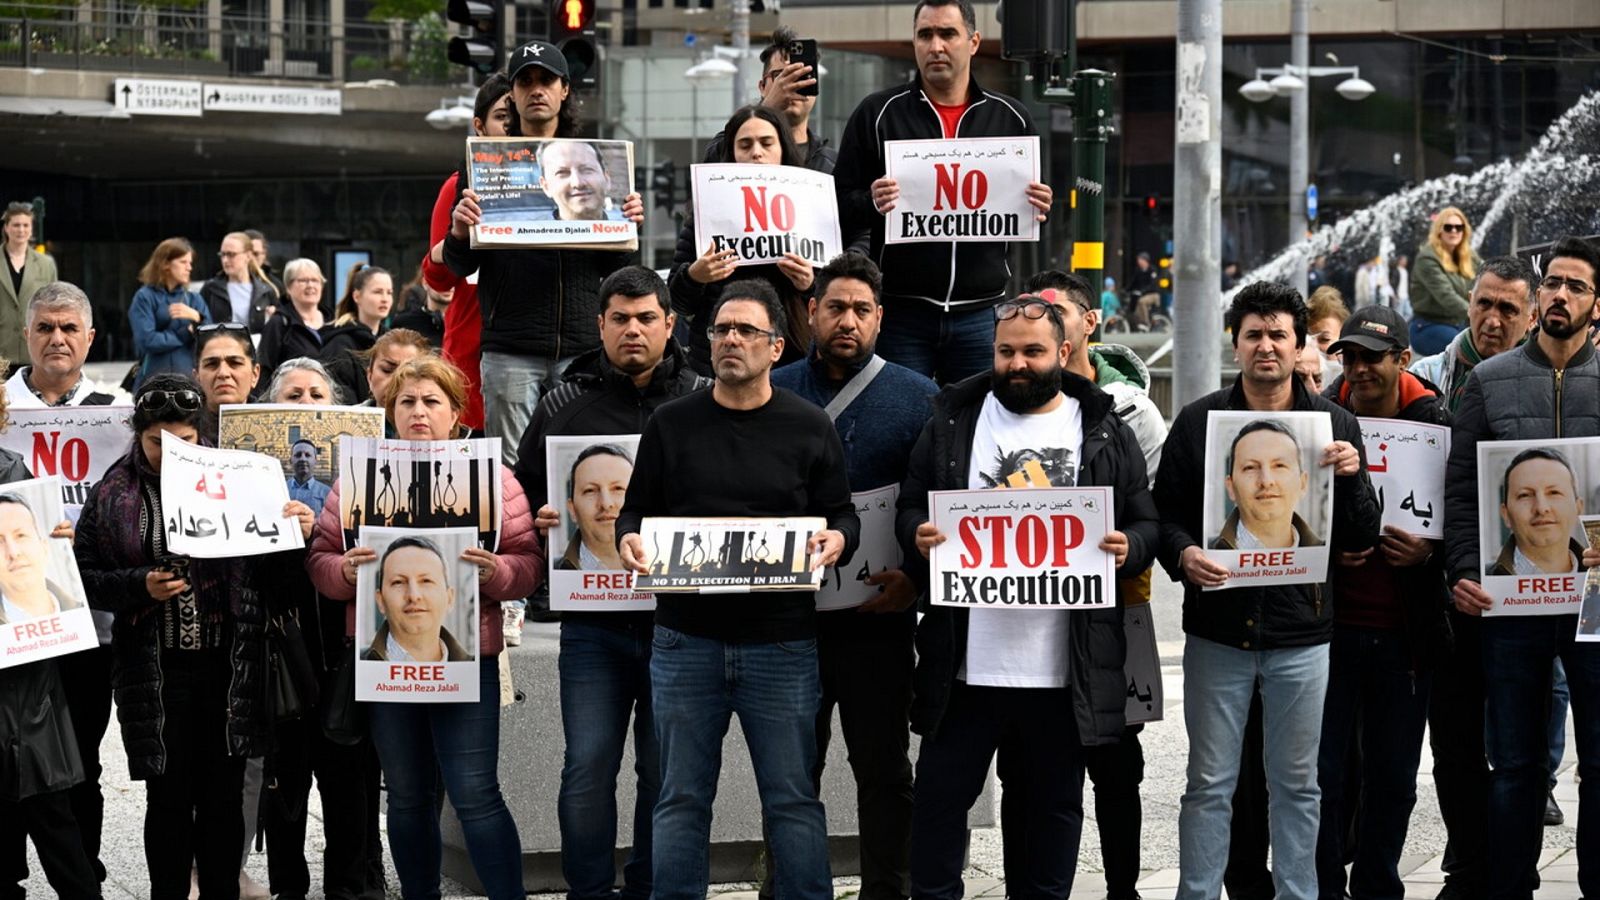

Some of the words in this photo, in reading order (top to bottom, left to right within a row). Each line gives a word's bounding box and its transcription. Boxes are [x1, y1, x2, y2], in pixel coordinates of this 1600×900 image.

[136, 83, 199, 96] ÖSTERMALM
[136, 99, 199, 110] NYBROPLAN
[223, 93, 265, 104] GUSTAV
[313, 96, 340, 107] TORG
[474, 152, 504, 166] May
[489, 166, 534, 174] International
[502, 183, 526, 191] Ahmad
[933, 163, 988, 210] No
[740, 186, 796, 233] No
[480, 225, 513, 235] Free
[516, 227, 564, 235] Ahmadreza
[565, 226, 591, 236] Djalali
[592, 223, 630, 234] Now!
[901, 210, 1020, 238] Execution
[712, 232, 826, 263] Execution
[195, 472, 227, 500] نه
[1035, 501, 1047, 511] من
[1050, 499, 1073, 512] کمپین
[1399, 488, 1433, 529] به
[168, 505, 230, 546] اعدام
[244, 513, 280, 544] به
[958, 514, 1085, 569] STOP
[1240, 551, 1296, 568] FREE
[1261, 569, 1284, 577] Reza
[1285, 566, 1307, 576] Jalali
[651, 577, 669, 586] NO
[671, 577, 688, 586] TO
[689, 576, 751, 586] EXECUTION
[753, 576, 767, 585] IN
[769, 575, 798, 585] IRAN
[941, 570, 1104, 605] Execution
[1518, 577, 1575, 594] FREE
[569, 592, 606, 601] Ahamad
[607, 592, 629, 601] Reza
[1503, 597, 1541, 606] Ahamad
[1544, 595, 1566, 604] Reza
[13, 617, 64, 642] FREE
[6, 641, 39, 657] Ahamad
[39, 638, 59, 649] Reza
[389, 665, 446, 681] FREE
[375, 683, 413, 692] Ahamad
[414, 683, 436, 692] Reza
[437, 683, 459, 692] Jalali
